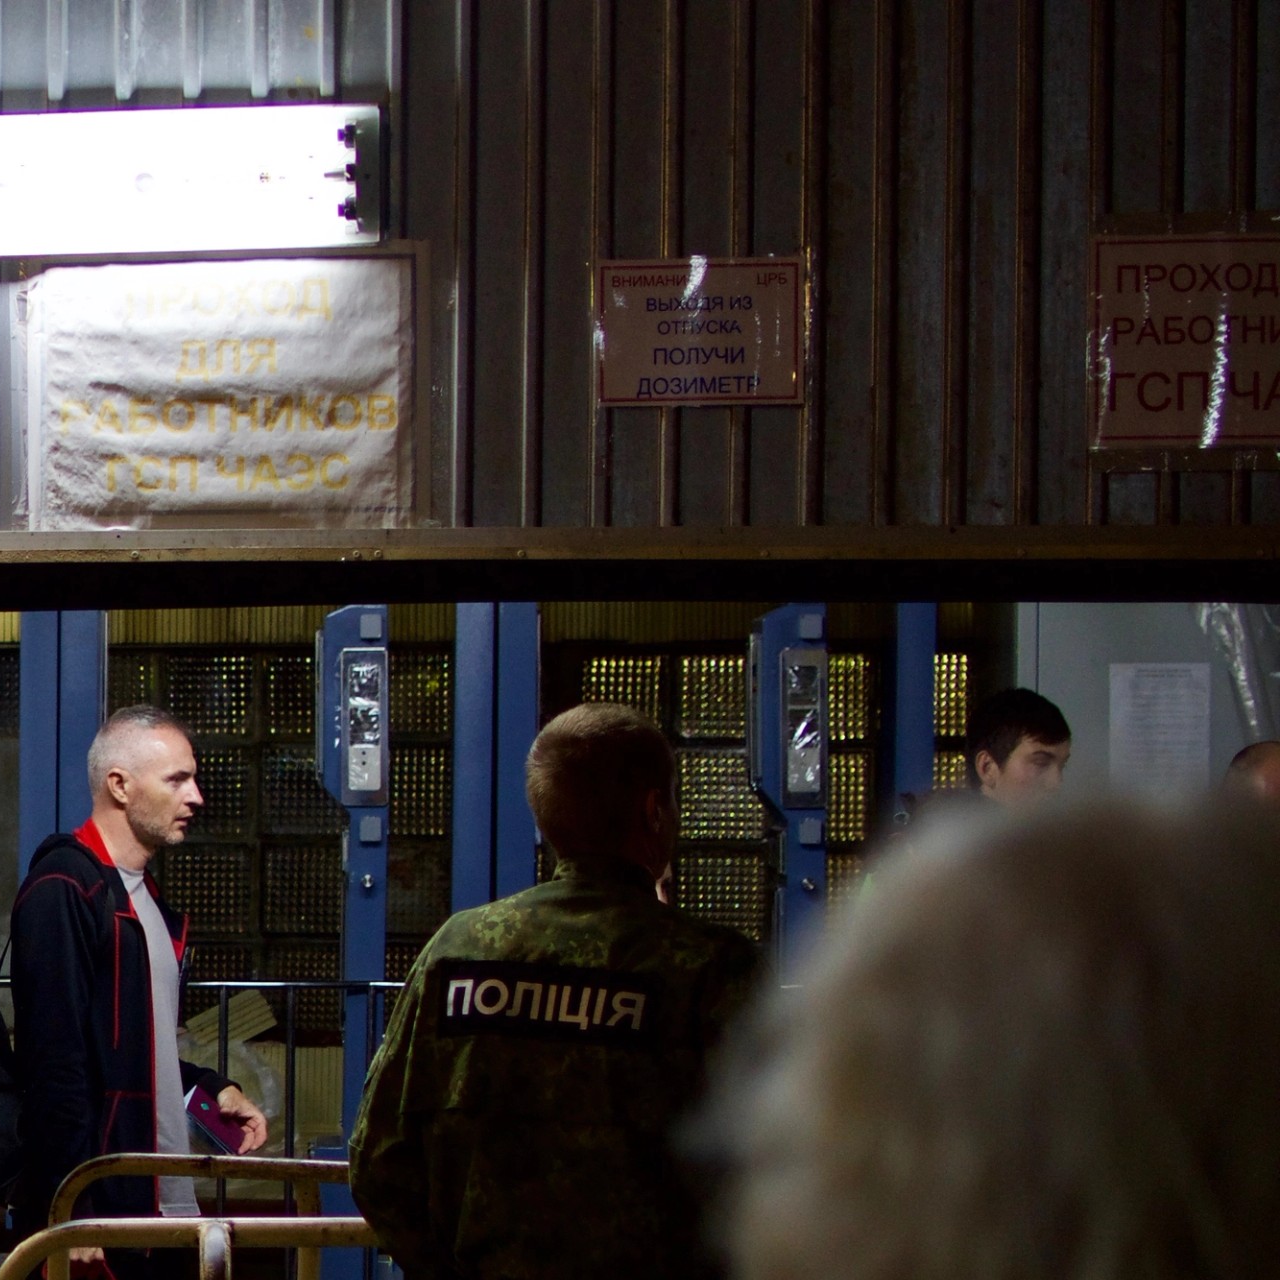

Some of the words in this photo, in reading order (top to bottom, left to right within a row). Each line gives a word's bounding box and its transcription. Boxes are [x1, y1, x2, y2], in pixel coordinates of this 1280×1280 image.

[611, 272, 696, 288] ВНИМАНИ
[756, 272, 788, 287] ЦРБ
[1115, 262, 1279, 298] ПРОХОД
[729, 295, 753, 311] ИЗ
[657, 320, 742, 335] ОТПУСКА
[175, 337, 278, 384] ДЛЯ
[653, 347, 745, 365] ПОЛУЧИ
[637, 375, 761, 399] ДОЗИМЕТР
[1109, 371, 1212, 412] ГСП
[58, 394, 399, 437] РАБОТНИКОВ
[104, 455, 199, 492] ГСП
[215, 453, 351, 492] ЧАЭС
[446, 978, 648, 1031] ПОЛІЦІЯ
